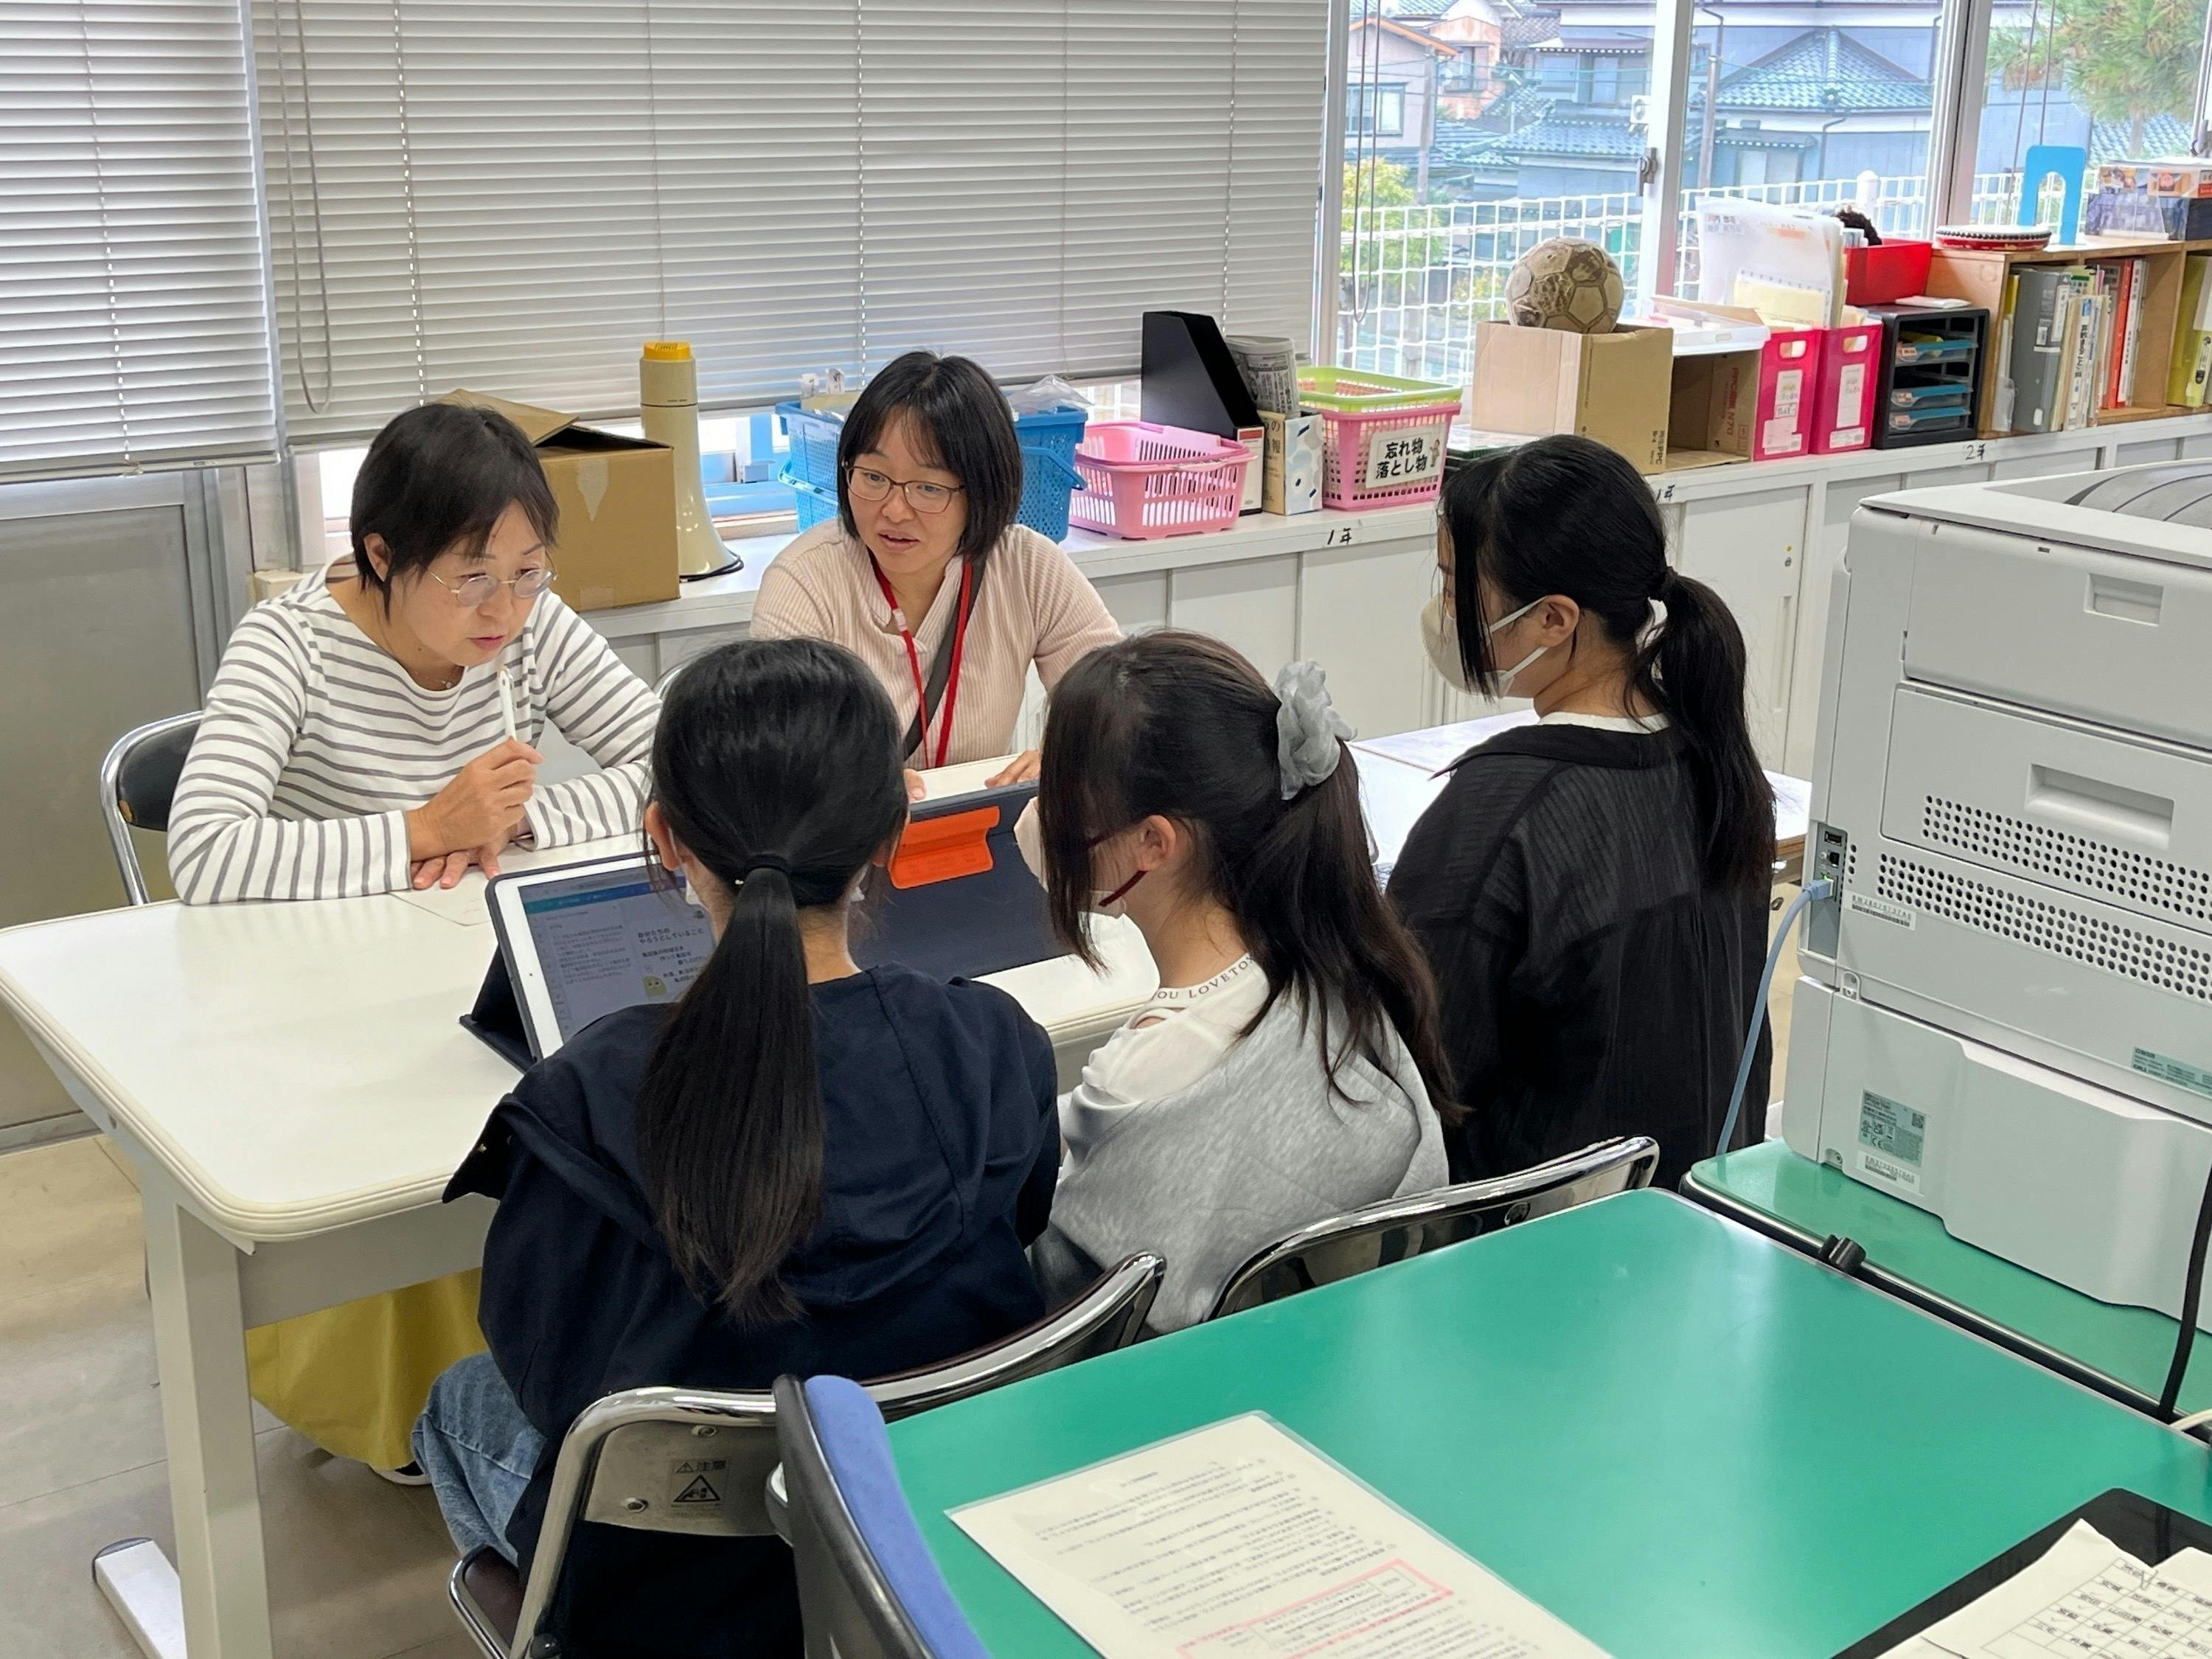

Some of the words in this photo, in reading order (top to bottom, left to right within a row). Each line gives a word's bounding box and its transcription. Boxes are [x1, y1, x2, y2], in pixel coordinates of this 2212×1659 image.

[1385, 437, 1424, 459] 忘れ物
[1376, 455, 1427, 479] 落とし物
[1327, 528, 1352, 546] 1年
